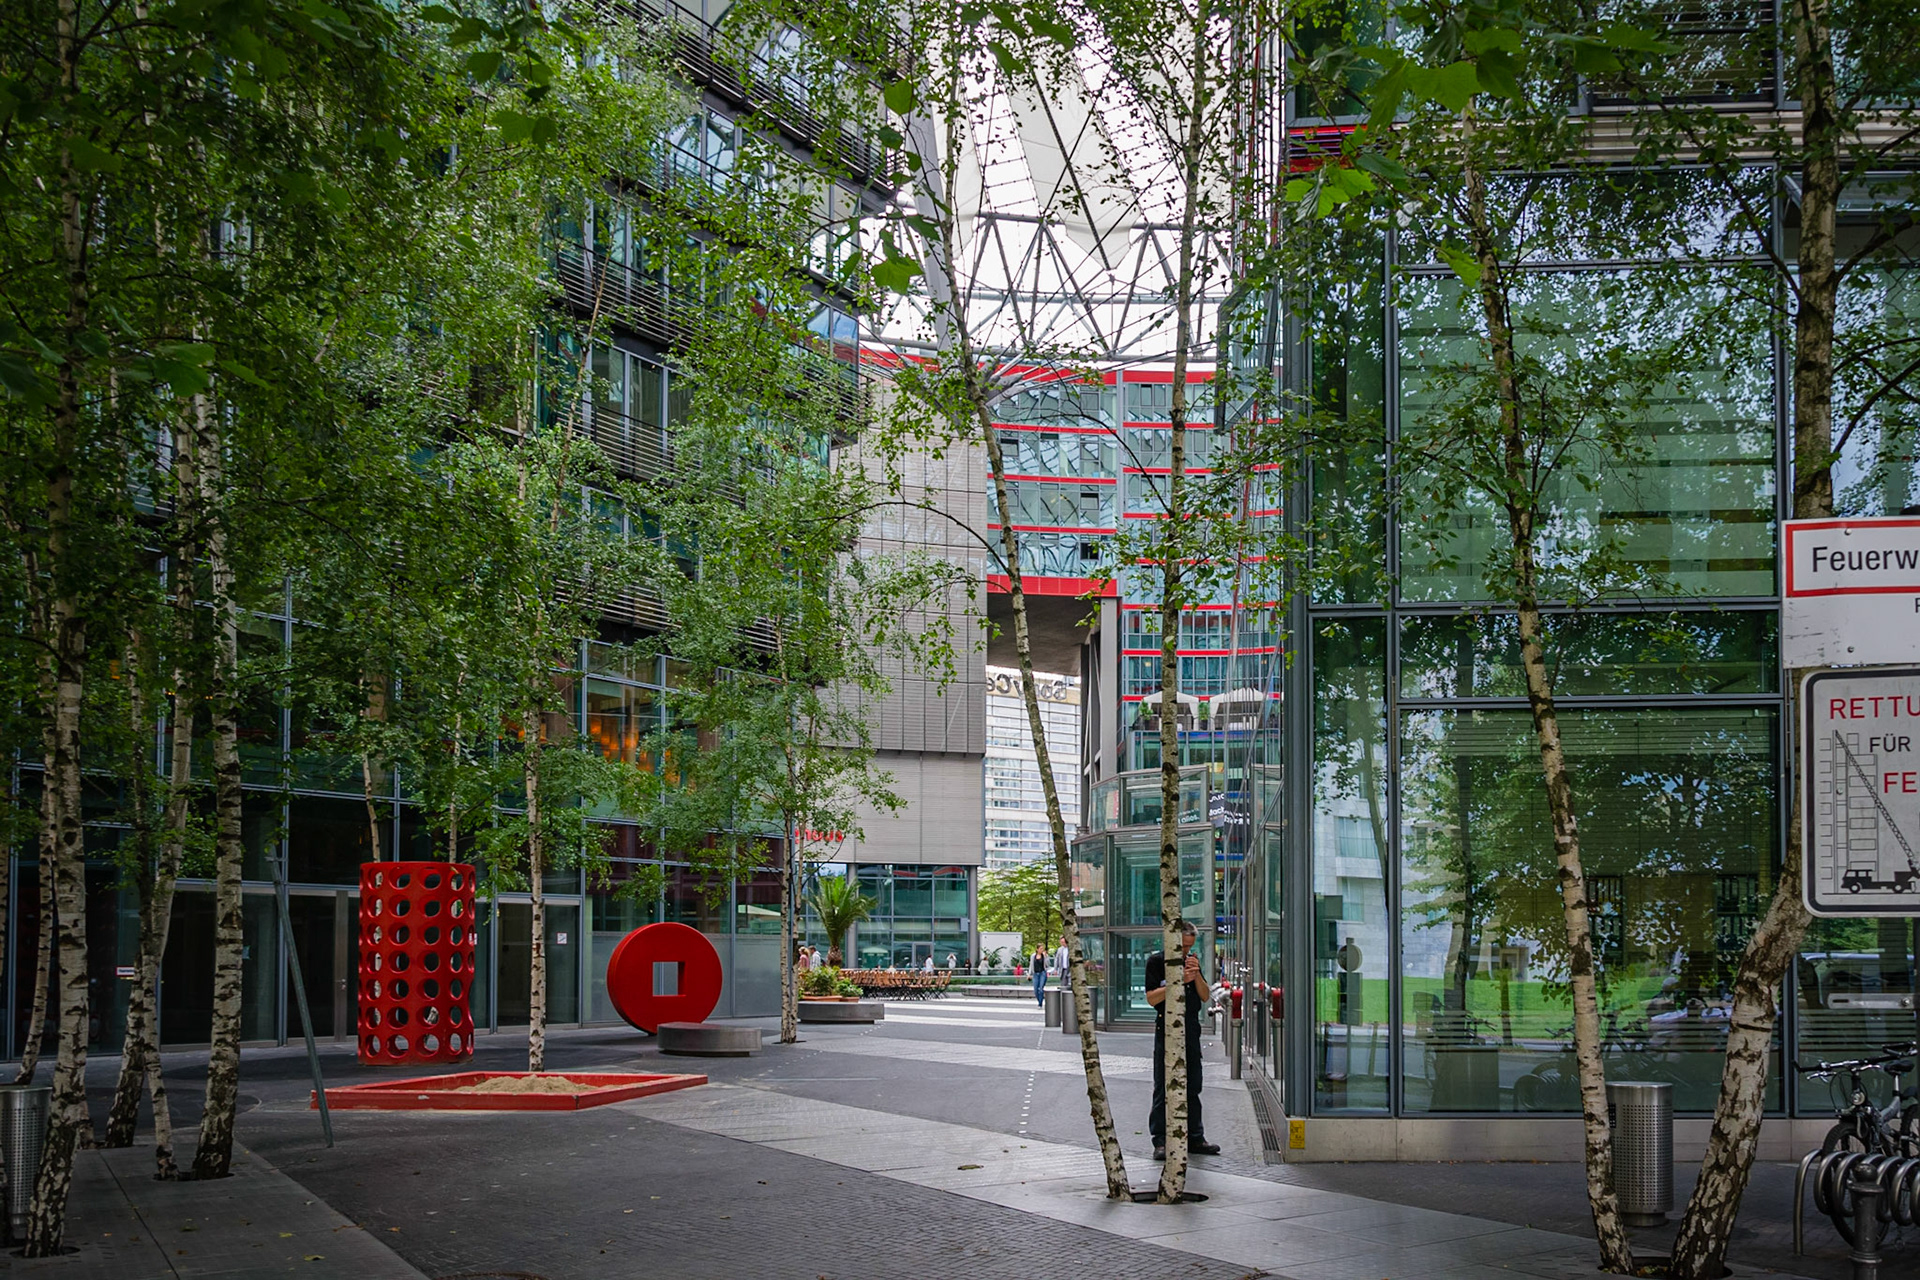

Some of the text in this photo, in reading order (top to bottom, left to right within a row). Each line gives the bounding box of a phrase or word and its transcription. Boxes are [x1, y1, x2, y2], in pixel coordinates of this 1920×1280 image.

[1812, 546, 1919, 573] Feuerw
[1869, 733, 1911, 753] FÜR
[1883, 771, 1918, 794] FE
